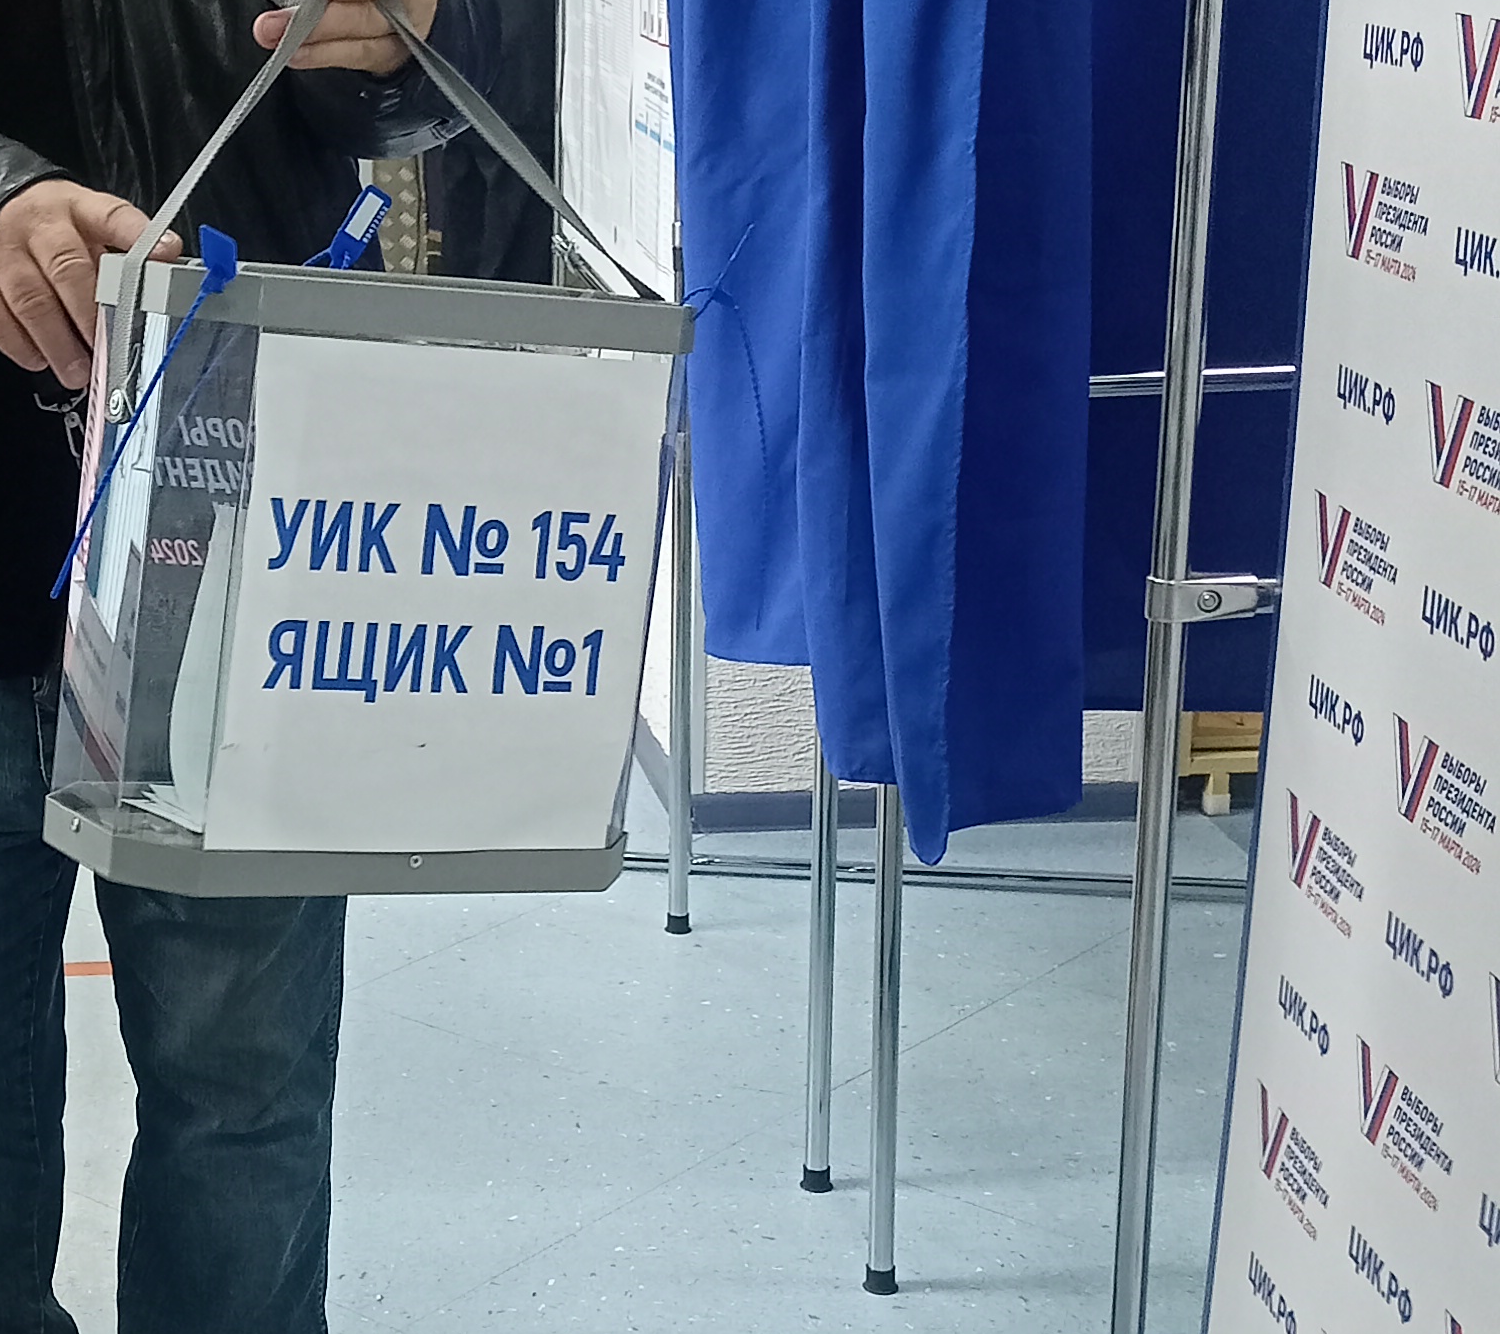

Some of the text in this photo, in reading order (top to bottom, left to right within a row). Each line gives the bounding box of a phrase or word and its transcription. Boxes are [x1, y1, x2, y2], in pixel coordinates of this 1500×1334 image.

[1363, 23, 1424, 72] ЦИК.РФ
[1381, 176, 1420, 205] ВЫБОРЫ
[1369, 226, 1404, 254] РОССИИ
[1375, 201, 1429, 236] ПРЕЗИДЕНТА
[1455, 226, 1500, 277] ЦИК.
[1336, 364, 1396, 426] ЦИК.РФ
[268, 497, 626, 583] УИК № 154
[1352, 516, 1390, 553] ВЫБОРЫ
[1341, 560, 1374, 594] РОССИИ
[1346, 539, 1399, 585] ПРЕЗИДЕНТА
[1421, 585, 1495, 662] ЦИК.РФ
[262, 619, 605, 703] ЯЩИК №1
[1309, 674, 1364, 747] ЦИК.РФ
[1441, 752, 1487, 796] ВЫБОРЫ
[1426, 796, 1466, 838] РОССИИ
[1433, 773, 1497, 834] ПРЕЗИДЕНТА
[1321, 825, 1356, 868] ВЫБОРЫ
[1437, 832, 1463, 865] МАРТА
[1462, 852, 1482, 875] 2024
[1311, 866, 1341, 904] РОССИИ
[1315, 846, 1364, 902] ПРЕЗИДЕНТА
[1386, 910, 1454, 999] ЦИК.РФ
[1278, 974, 1330, 1056] ЦИК.РФ
[1401, 1085, 1443, 1138] ВЫБОРЫ
[1387, 1125, 1424, 1173] РОССИИ
[1394, 1105, 1453, 1176] ПРЕЗИДЕНТА
[1397, 1161, 1422, 1195] МАРТА
[1420, 1185, 1439, 1212] 2024
[1348, 1225, 1412, 1323] ЦИК.РФ
